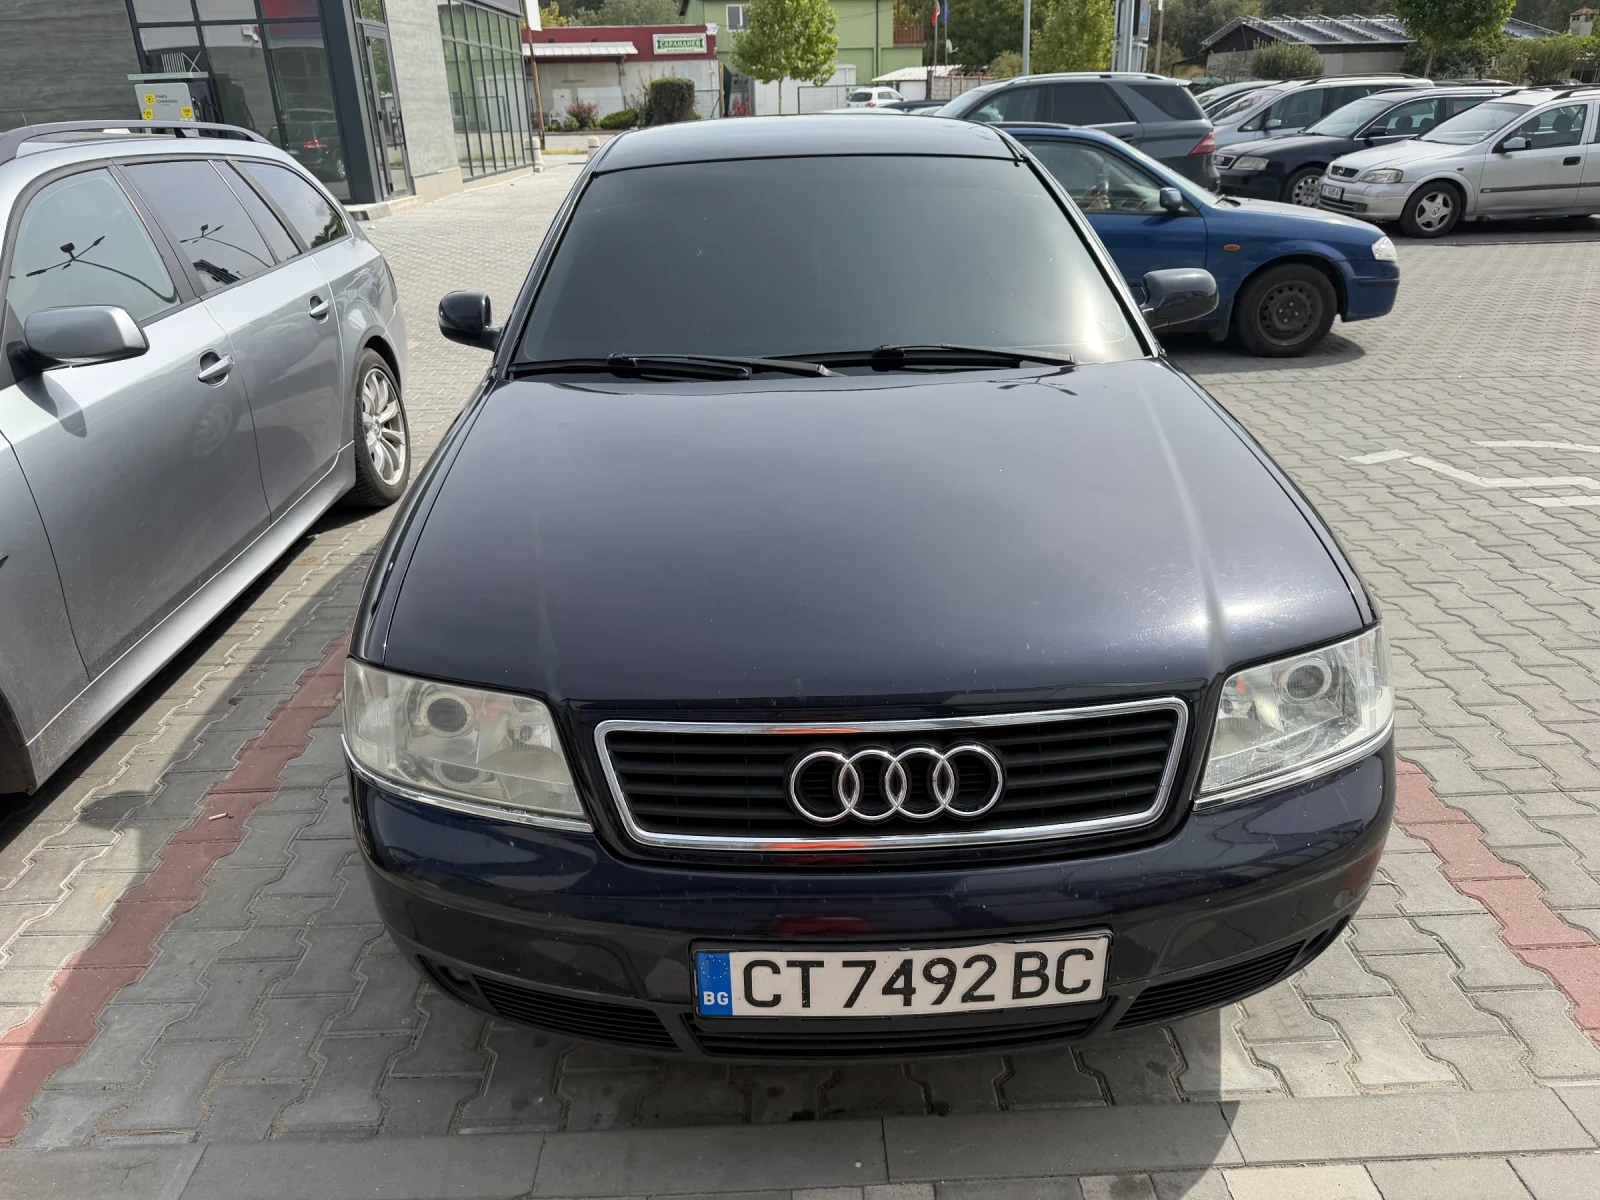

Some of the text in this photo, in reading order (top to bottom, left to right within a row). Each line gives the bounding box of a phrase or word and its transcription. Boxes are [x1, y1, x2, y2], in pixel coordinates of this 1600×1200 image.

[743, 947, 1094, 1009] CT 7492 BC
[703, 991, 729, 1006] BG
